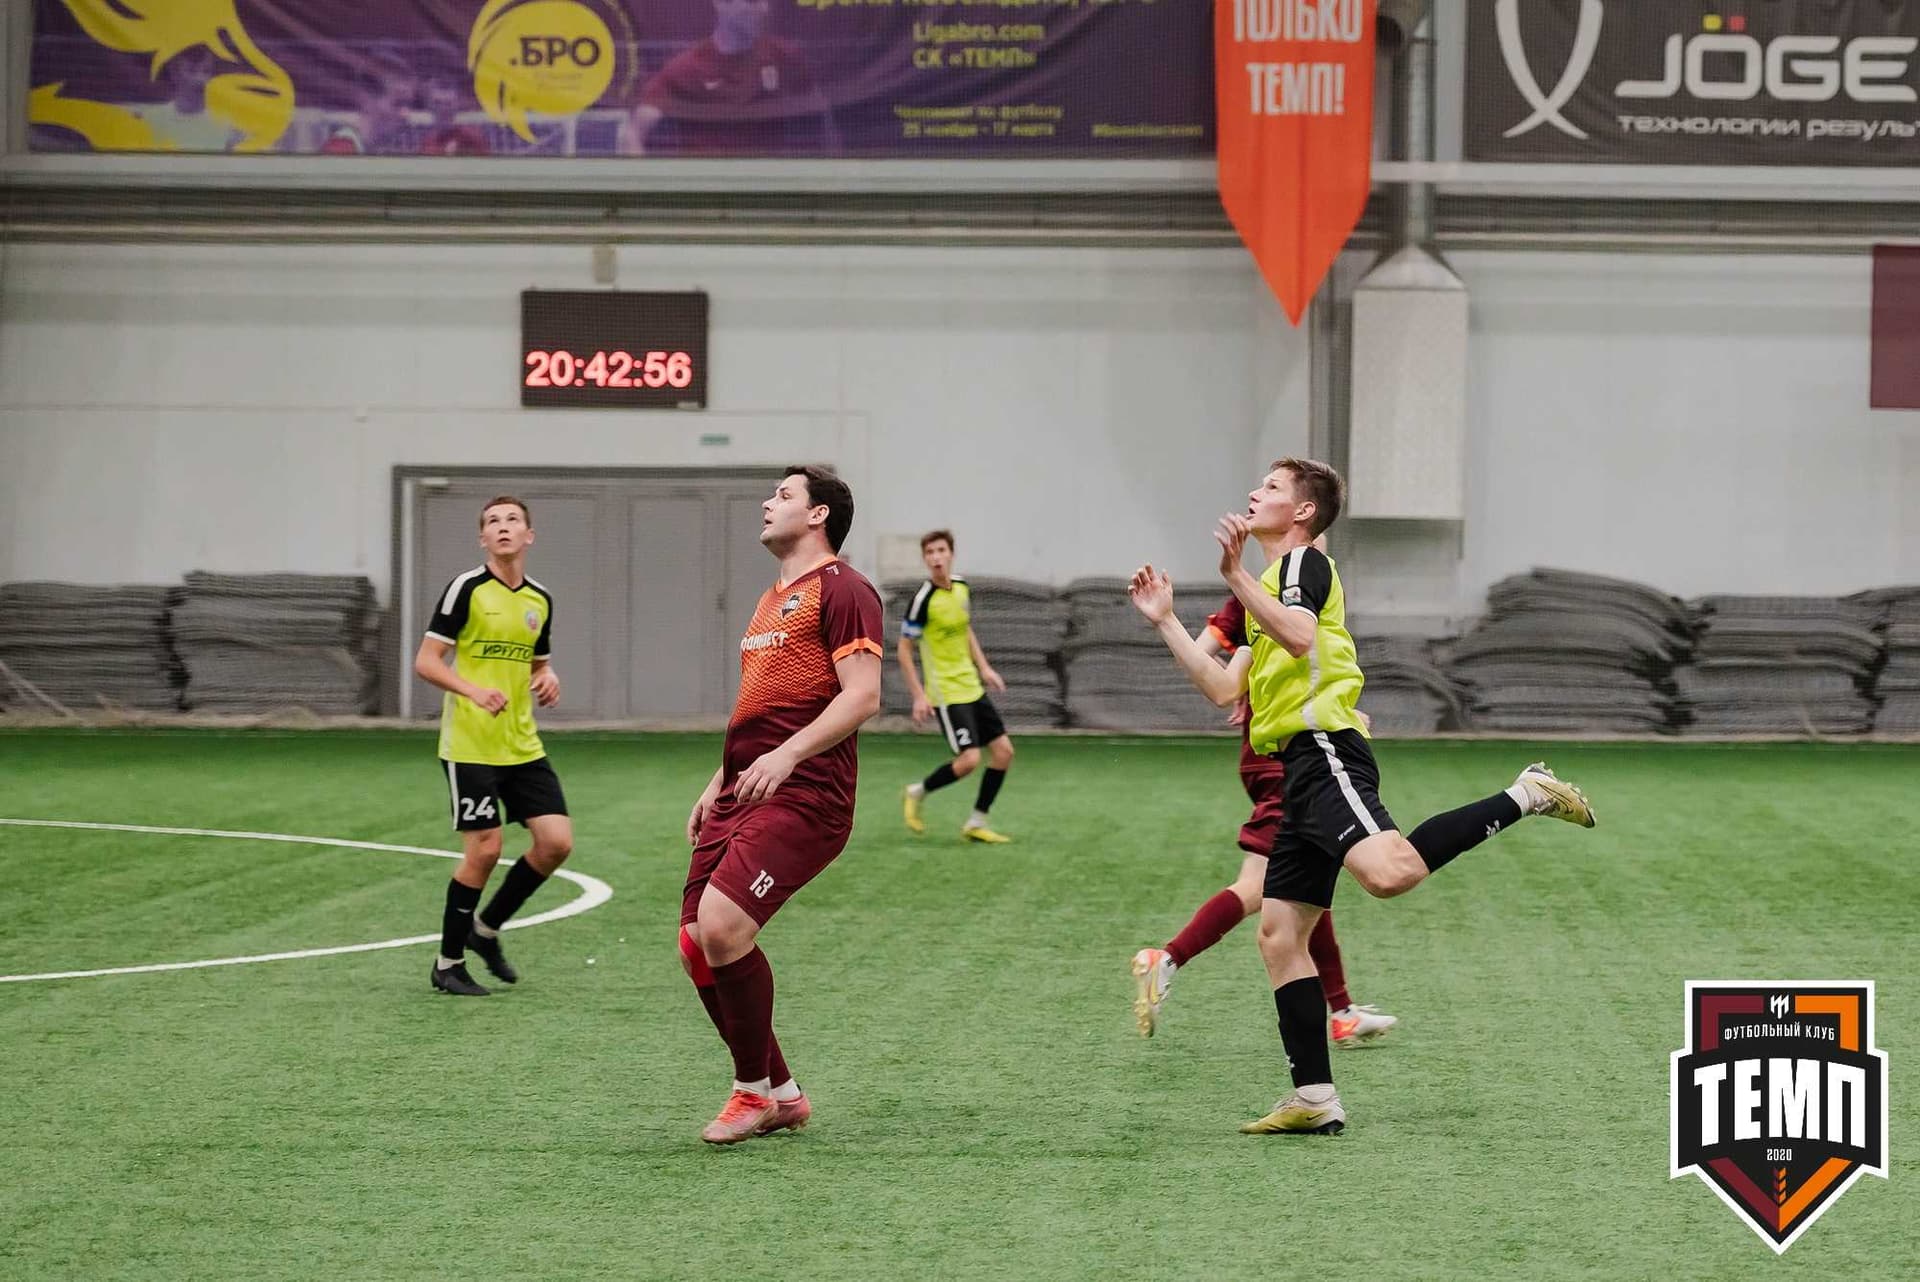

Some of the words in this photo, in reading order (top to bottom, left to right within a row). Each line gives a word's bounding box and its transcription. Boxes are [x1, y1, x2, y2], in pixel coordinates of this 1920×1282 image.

[913, 21, 1045, 43] Ligabro.com
[1246, 62, 1345, 116] ТЕМП!
[1617, 115, 1801, 137] технологии
[525, 350, 693, 388] 20:42:56
[956, 727, 973, 746] 2
[460, 796, 496, 821] 24
[749, 869, 775, 899] 13
